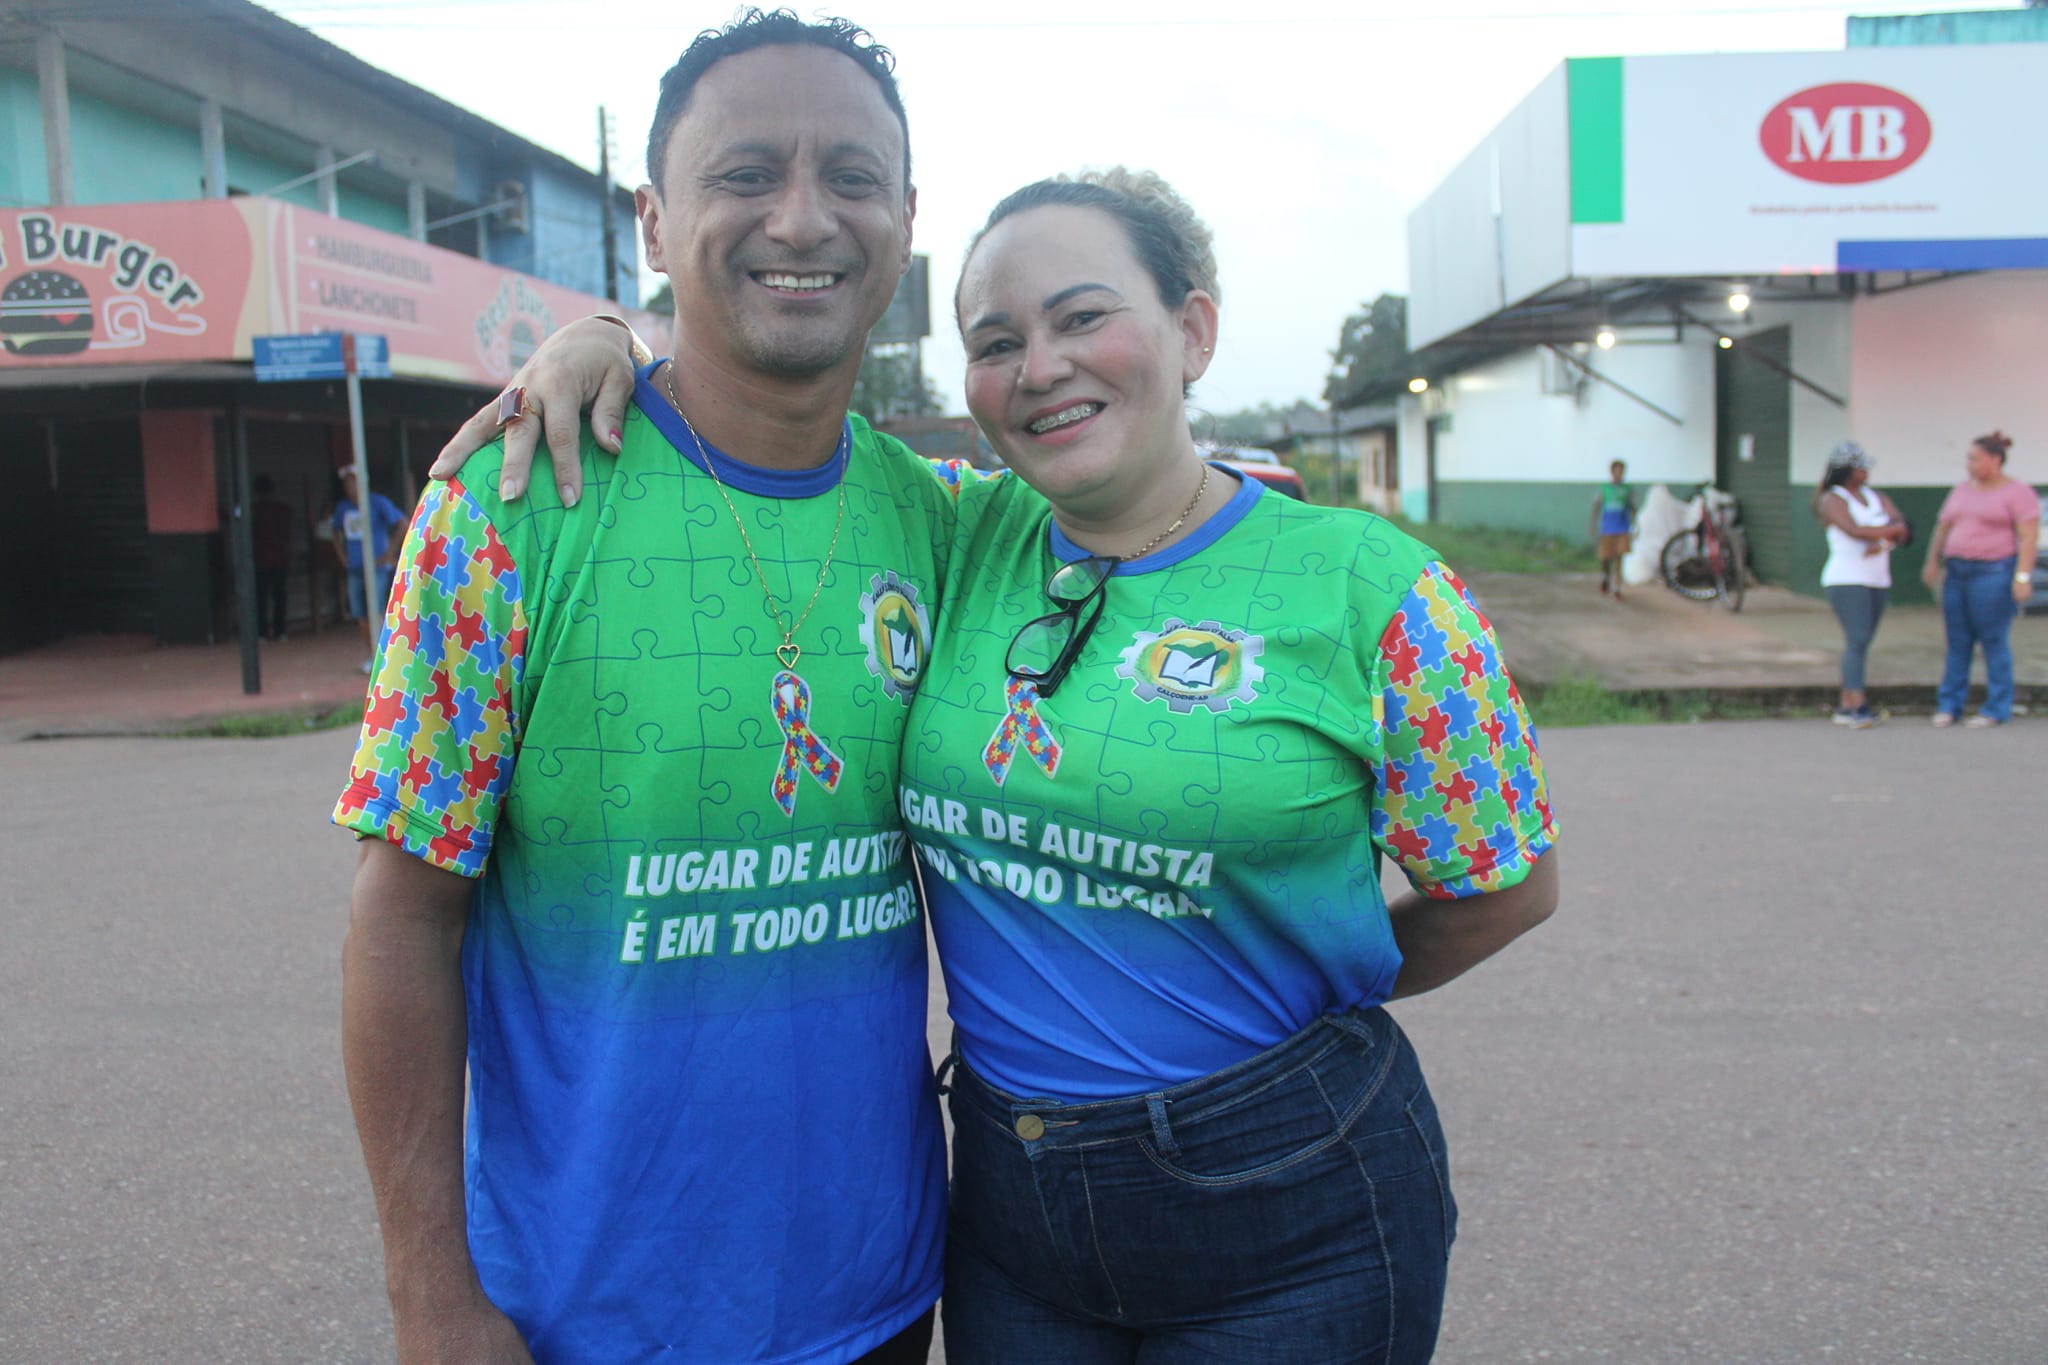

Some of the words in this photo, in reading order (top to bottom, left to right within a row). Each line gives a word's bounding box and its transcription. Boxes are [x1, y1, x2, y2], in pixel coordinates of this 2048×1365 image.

[1786, 105, 1907, 162] MB
[19, 214, 202, 309] Burger
[624, 848, 759, 897] LUGAR
[768, 841, 813, 887] DE
[982, 807, 1028, 849] DE
[1039, 822, 1214, 887] AUTISTA
[959, 853, 1063, 904] TODO
[620, 909, 648, 962] É
[656, 914, 718, 961] EM
[731, 902, 829, 953] TODO
